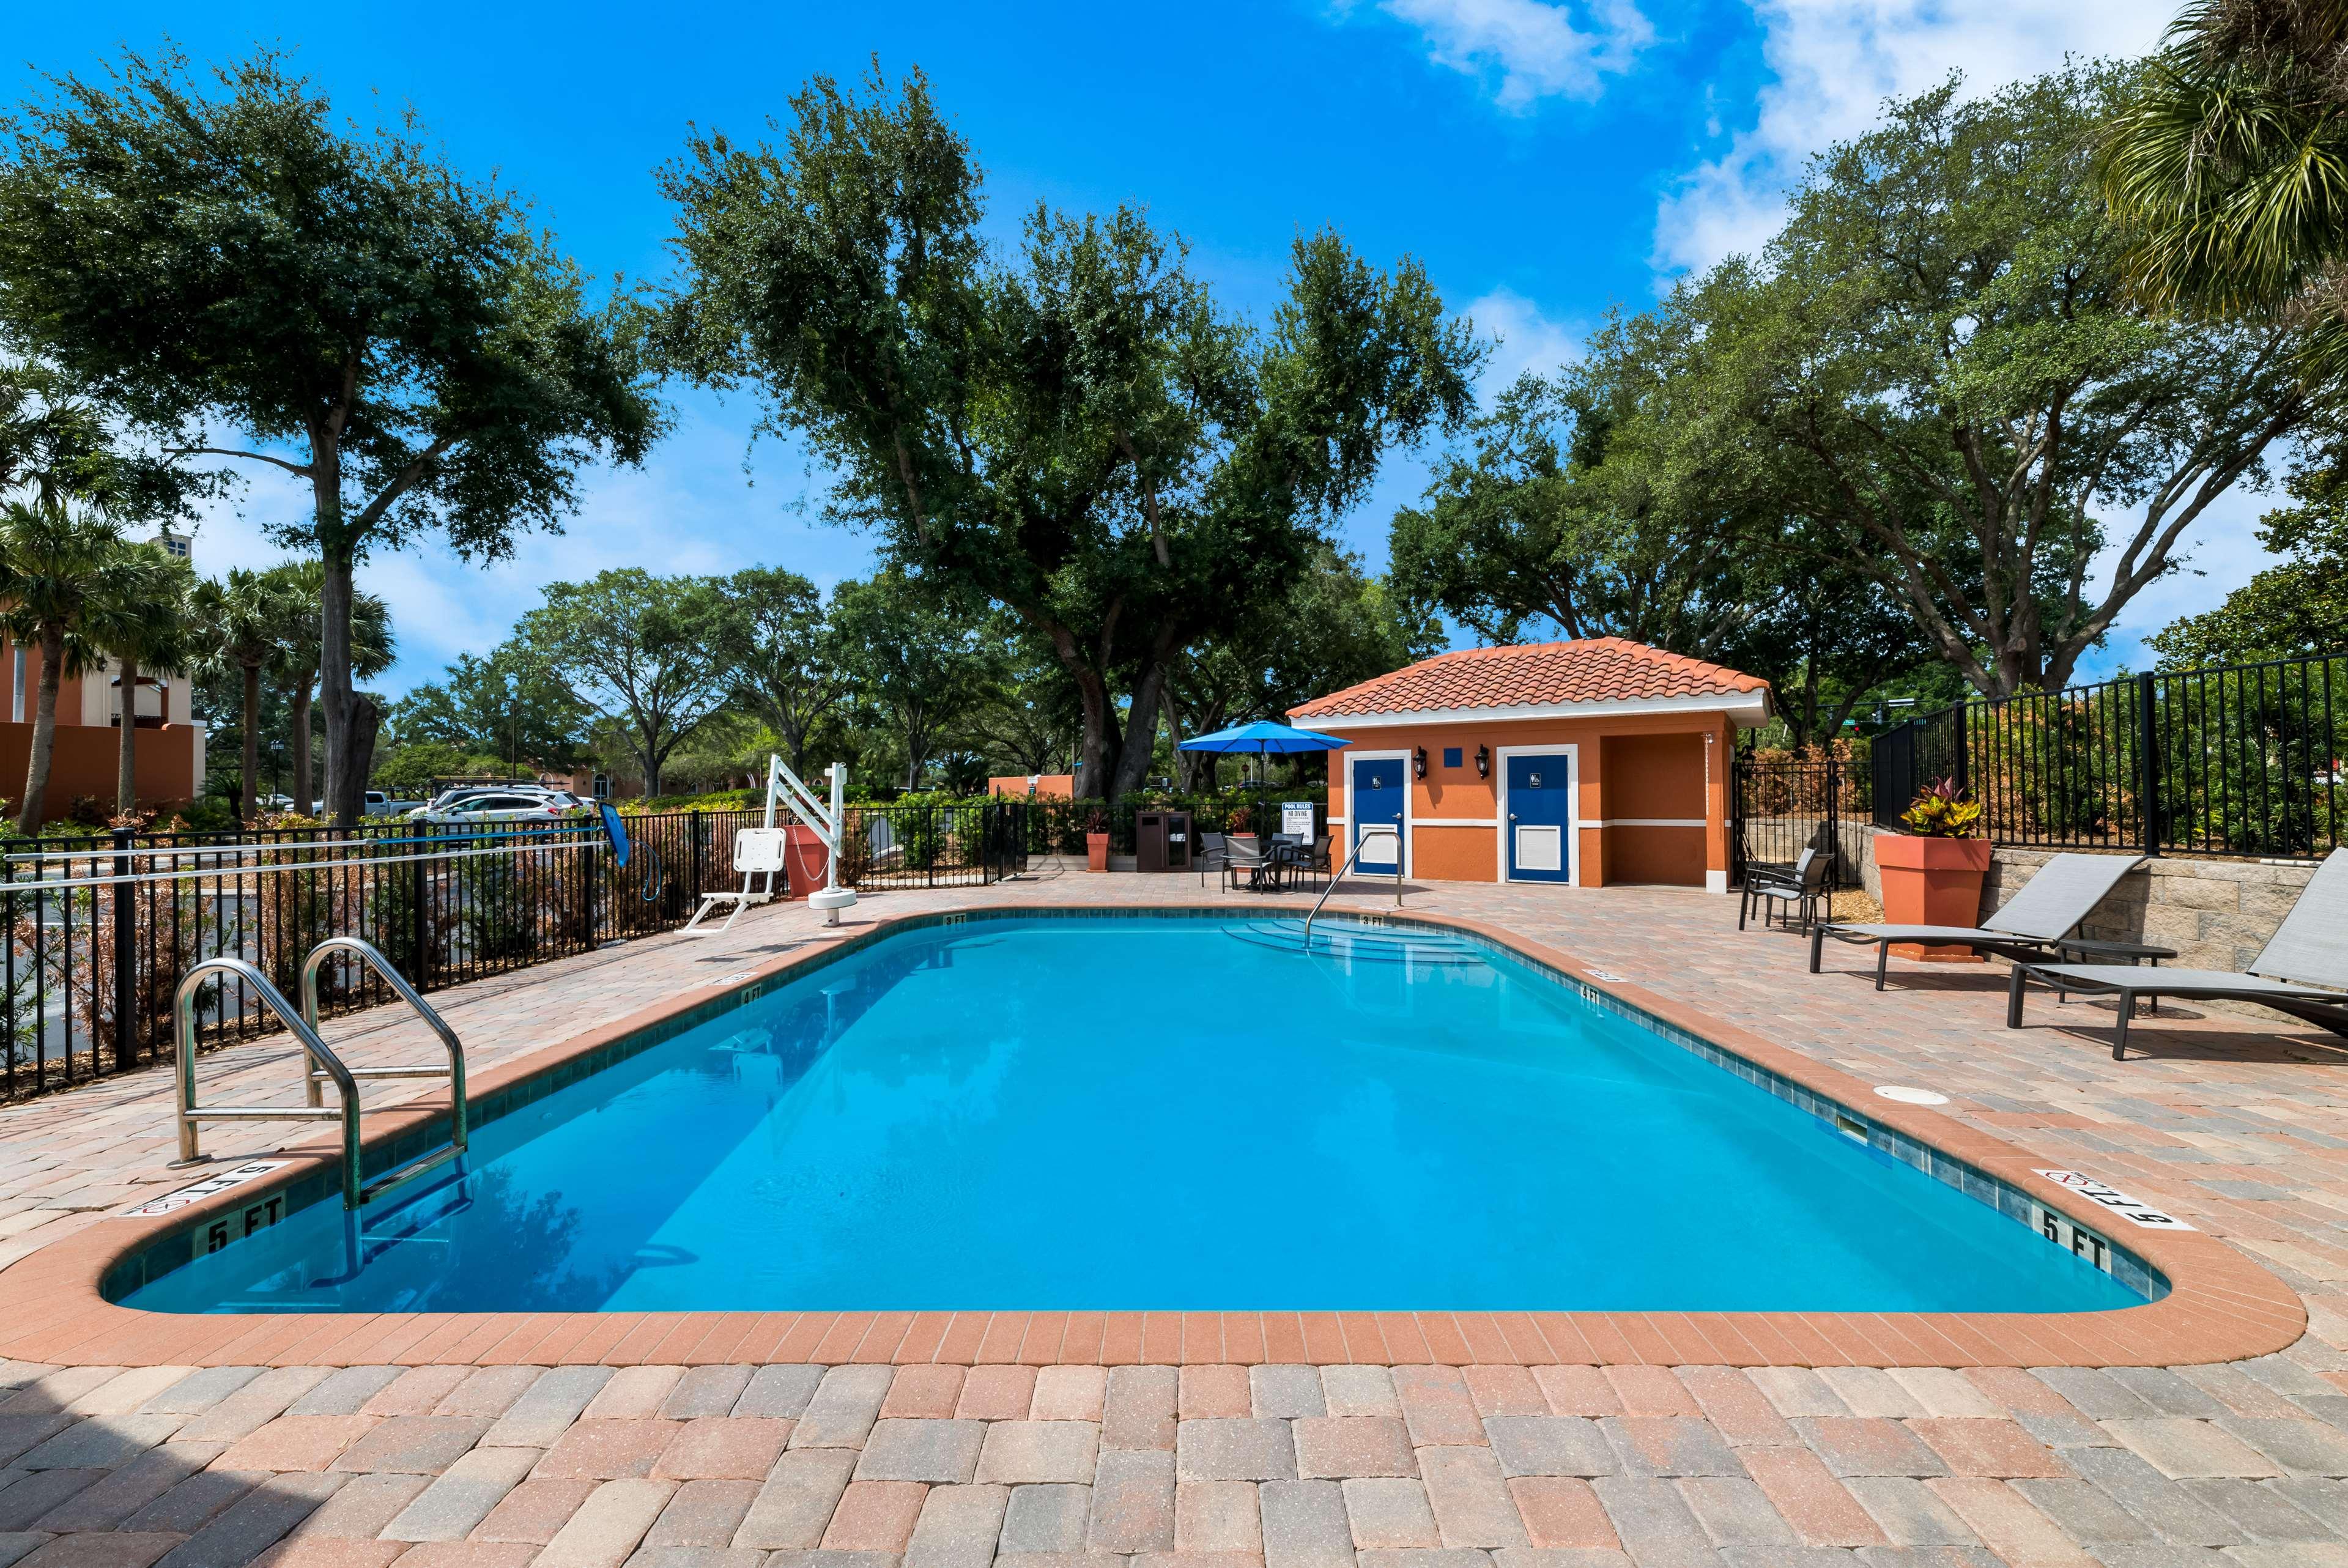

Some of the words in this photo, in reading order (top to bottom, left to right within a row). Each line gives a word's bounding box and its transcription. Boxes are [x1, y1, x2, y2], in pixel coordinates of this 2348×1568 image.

[946, 917, 952, 925] 3
[955, 915, 965, 924] FT
[1363, 916, 1368, 925] 3
[1372, 917, 1382, 926] FT
[744, 991, 749, 1004] 4
[1583, 985, 1587, 999] 4
[1590, 988, 1598, 1004] FT
[2043, 1210, 2059, 1244] 5
[209, 1219, 228, 1256] 5
